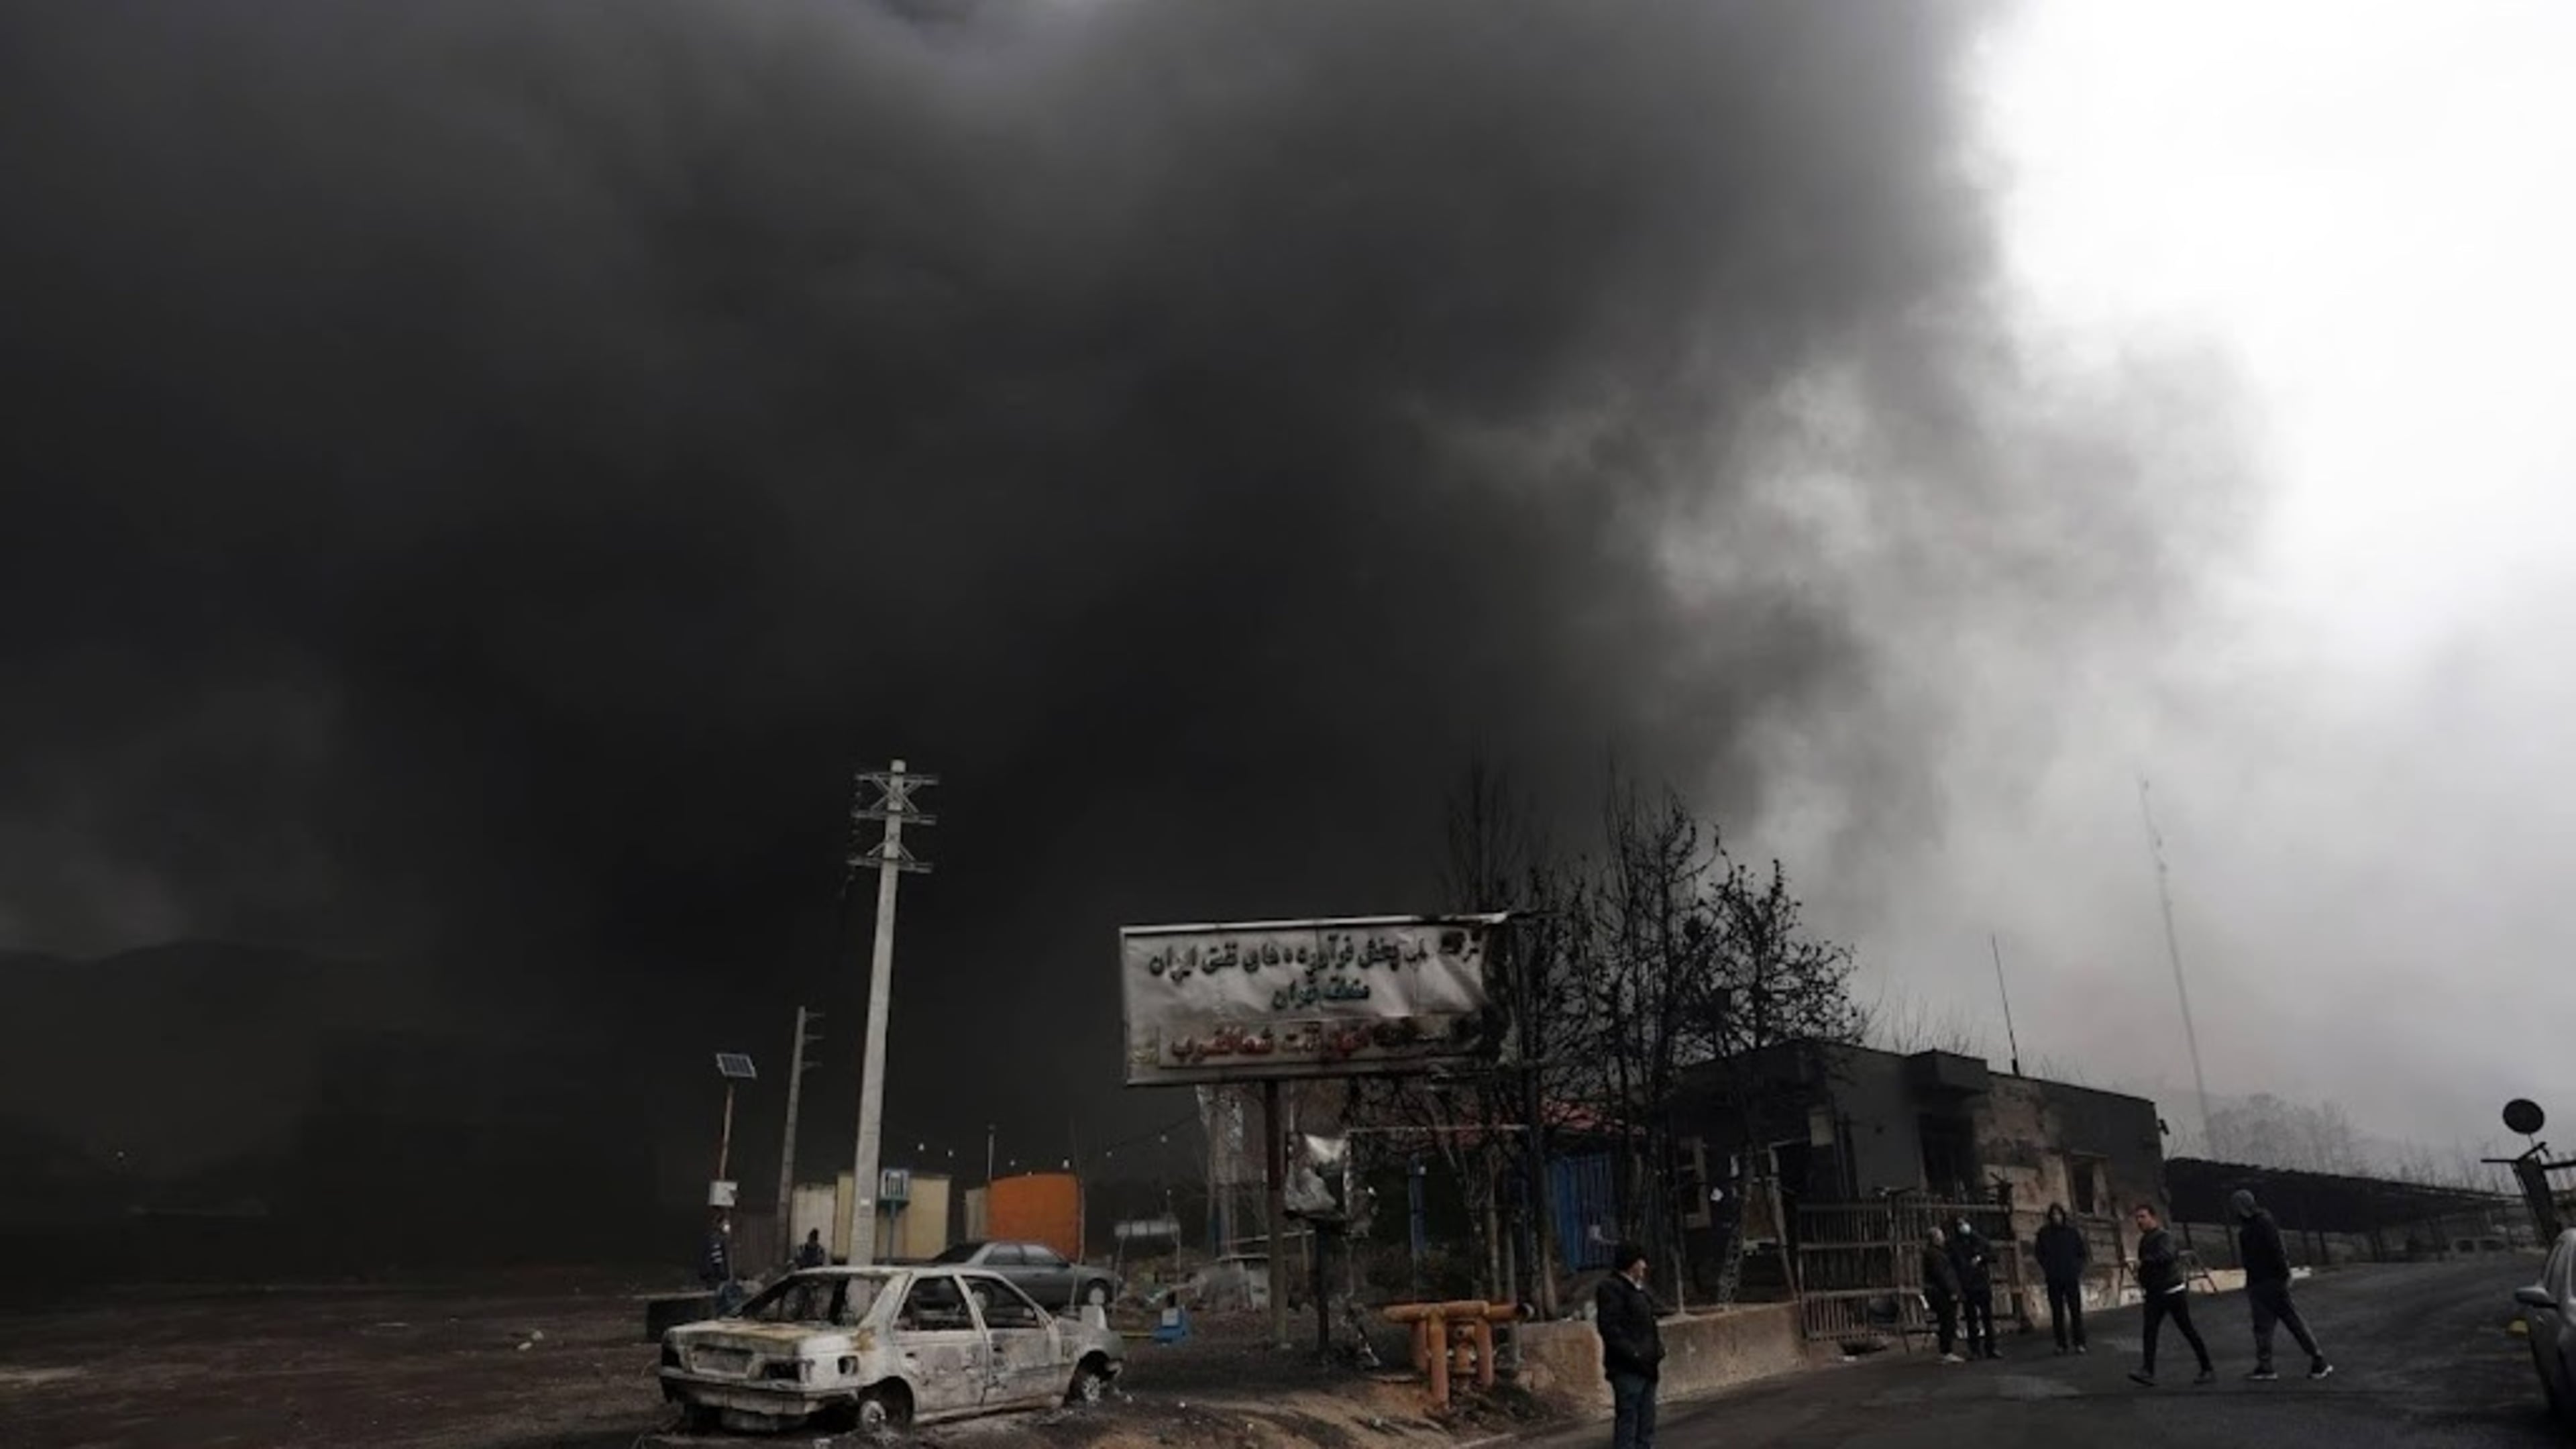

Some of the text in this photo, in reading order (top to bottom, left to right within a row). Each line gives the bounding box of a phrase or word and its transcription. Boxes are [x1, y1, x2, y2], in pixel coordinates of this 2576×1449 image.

[1149, 944, 1197, 985] ایران
[1201, 941, 1238, 975] نفتی
[1357, 936, 1400, 971] پخش
